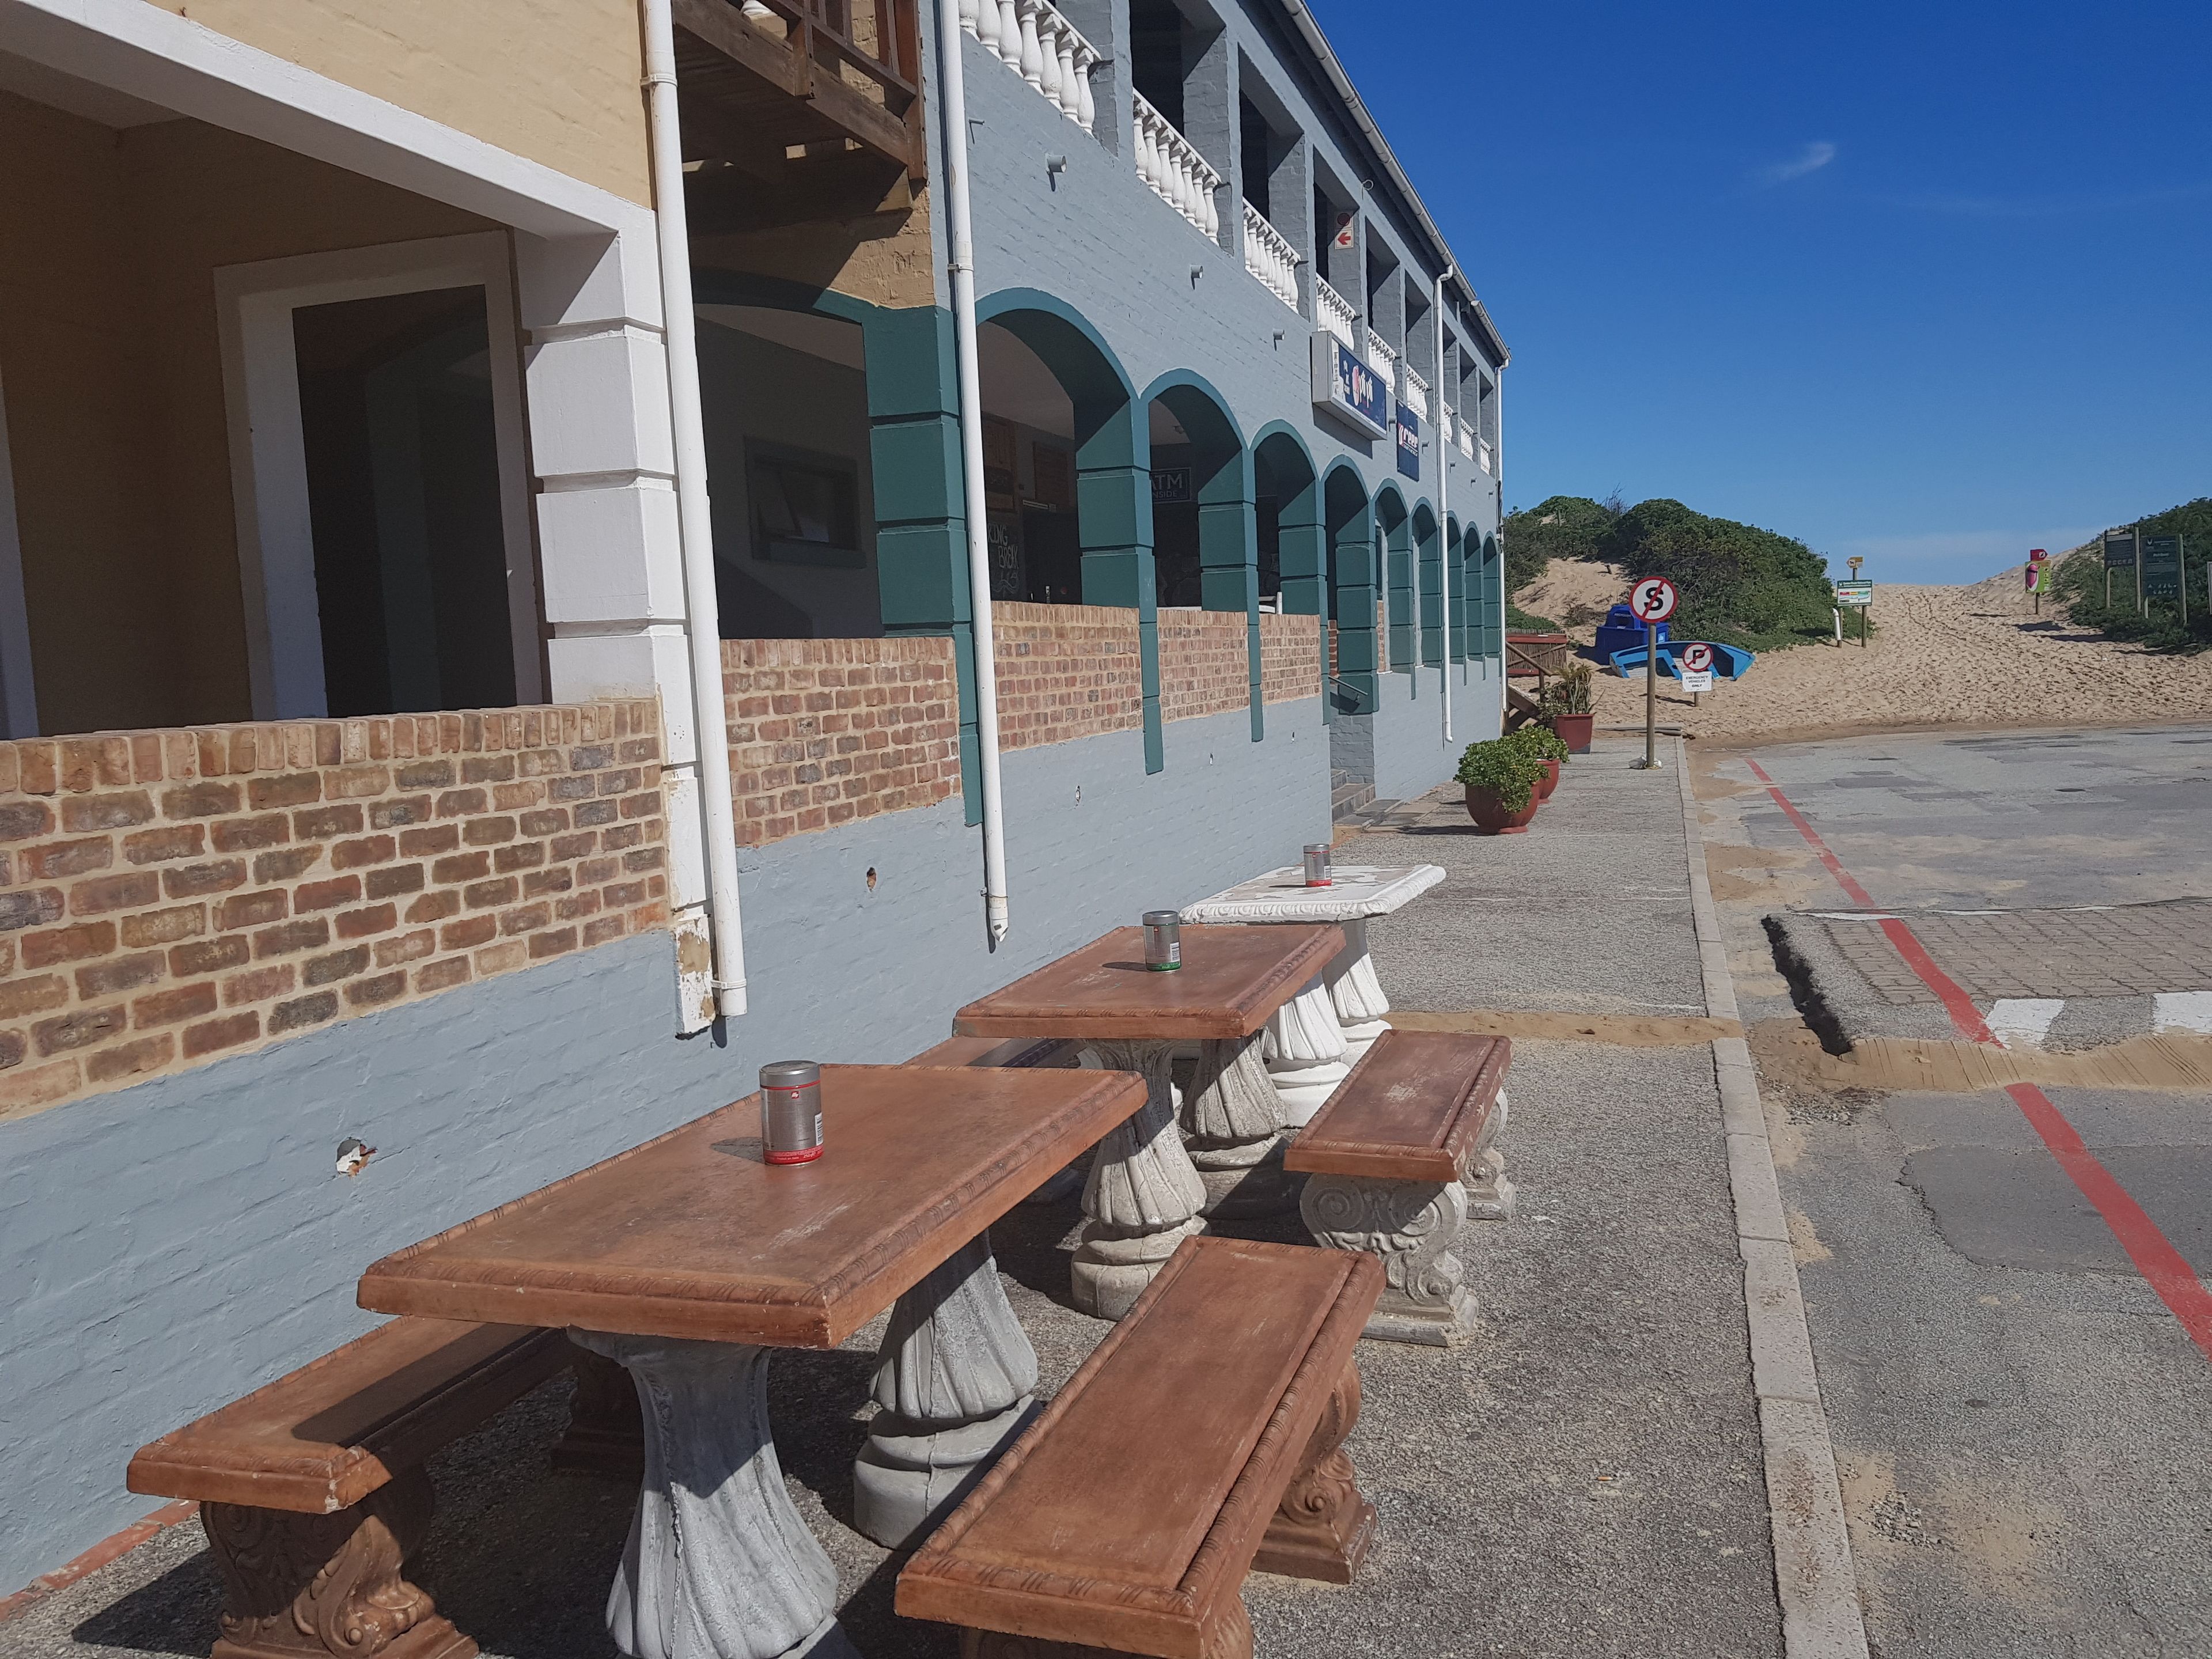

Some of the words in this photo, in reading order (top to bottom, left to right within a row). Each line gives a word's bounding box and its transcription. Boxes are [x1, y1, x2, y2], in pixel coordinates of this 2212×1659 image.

[1153, 490, 1178, 498] NSIDE
[1644, 587, 1664, 611] S
[1692, 650, 1705, 665] P
